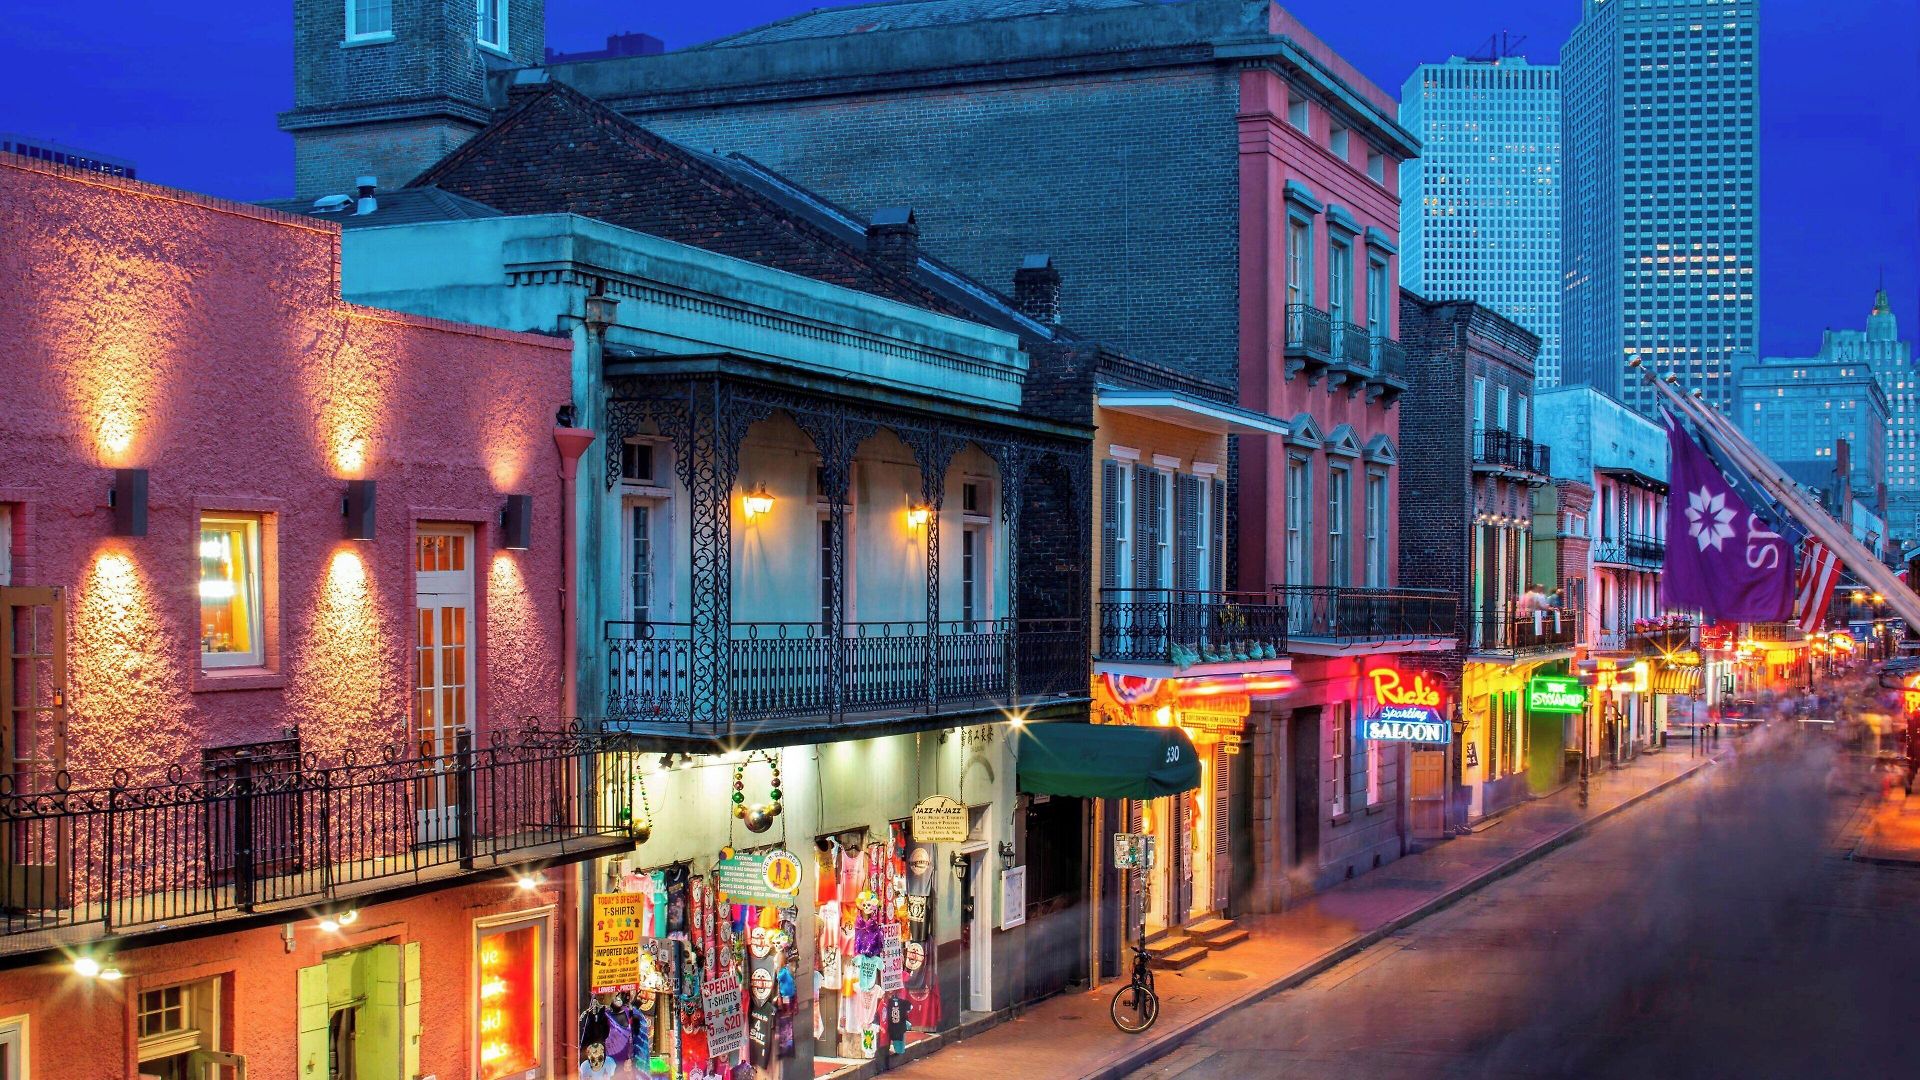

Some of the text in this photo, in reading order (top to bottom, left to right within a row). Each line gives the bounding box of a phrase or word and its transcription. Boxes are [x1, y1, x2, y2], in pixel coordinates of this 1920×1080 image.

[1368, 668, 1440, 706] Rick's
[1532, 692, 1584, 708] SWAMP
[1382, 706, 1428, 721] Sporting
[1370, 722, 1440, 740] SALOON
[604, 906, 635, 916] T-SHIRTS
[604, 932, 610, 942] 5
[619, 930, 633, 942] $20
[596, 947, 622, 957] IMPORTED
[704, 976, 739, 998] SPECIAL
[708, 991, 737, 1008] T-SHIRTS
[707, 1023, 715, 1037] 5
[716, 1026, 724, 1034] FOR
[724, 1014, 740, 1032] $20
[710, 1036, 727, 1047] LOWEST
[728, 1031, 742, 1041] PRICES
